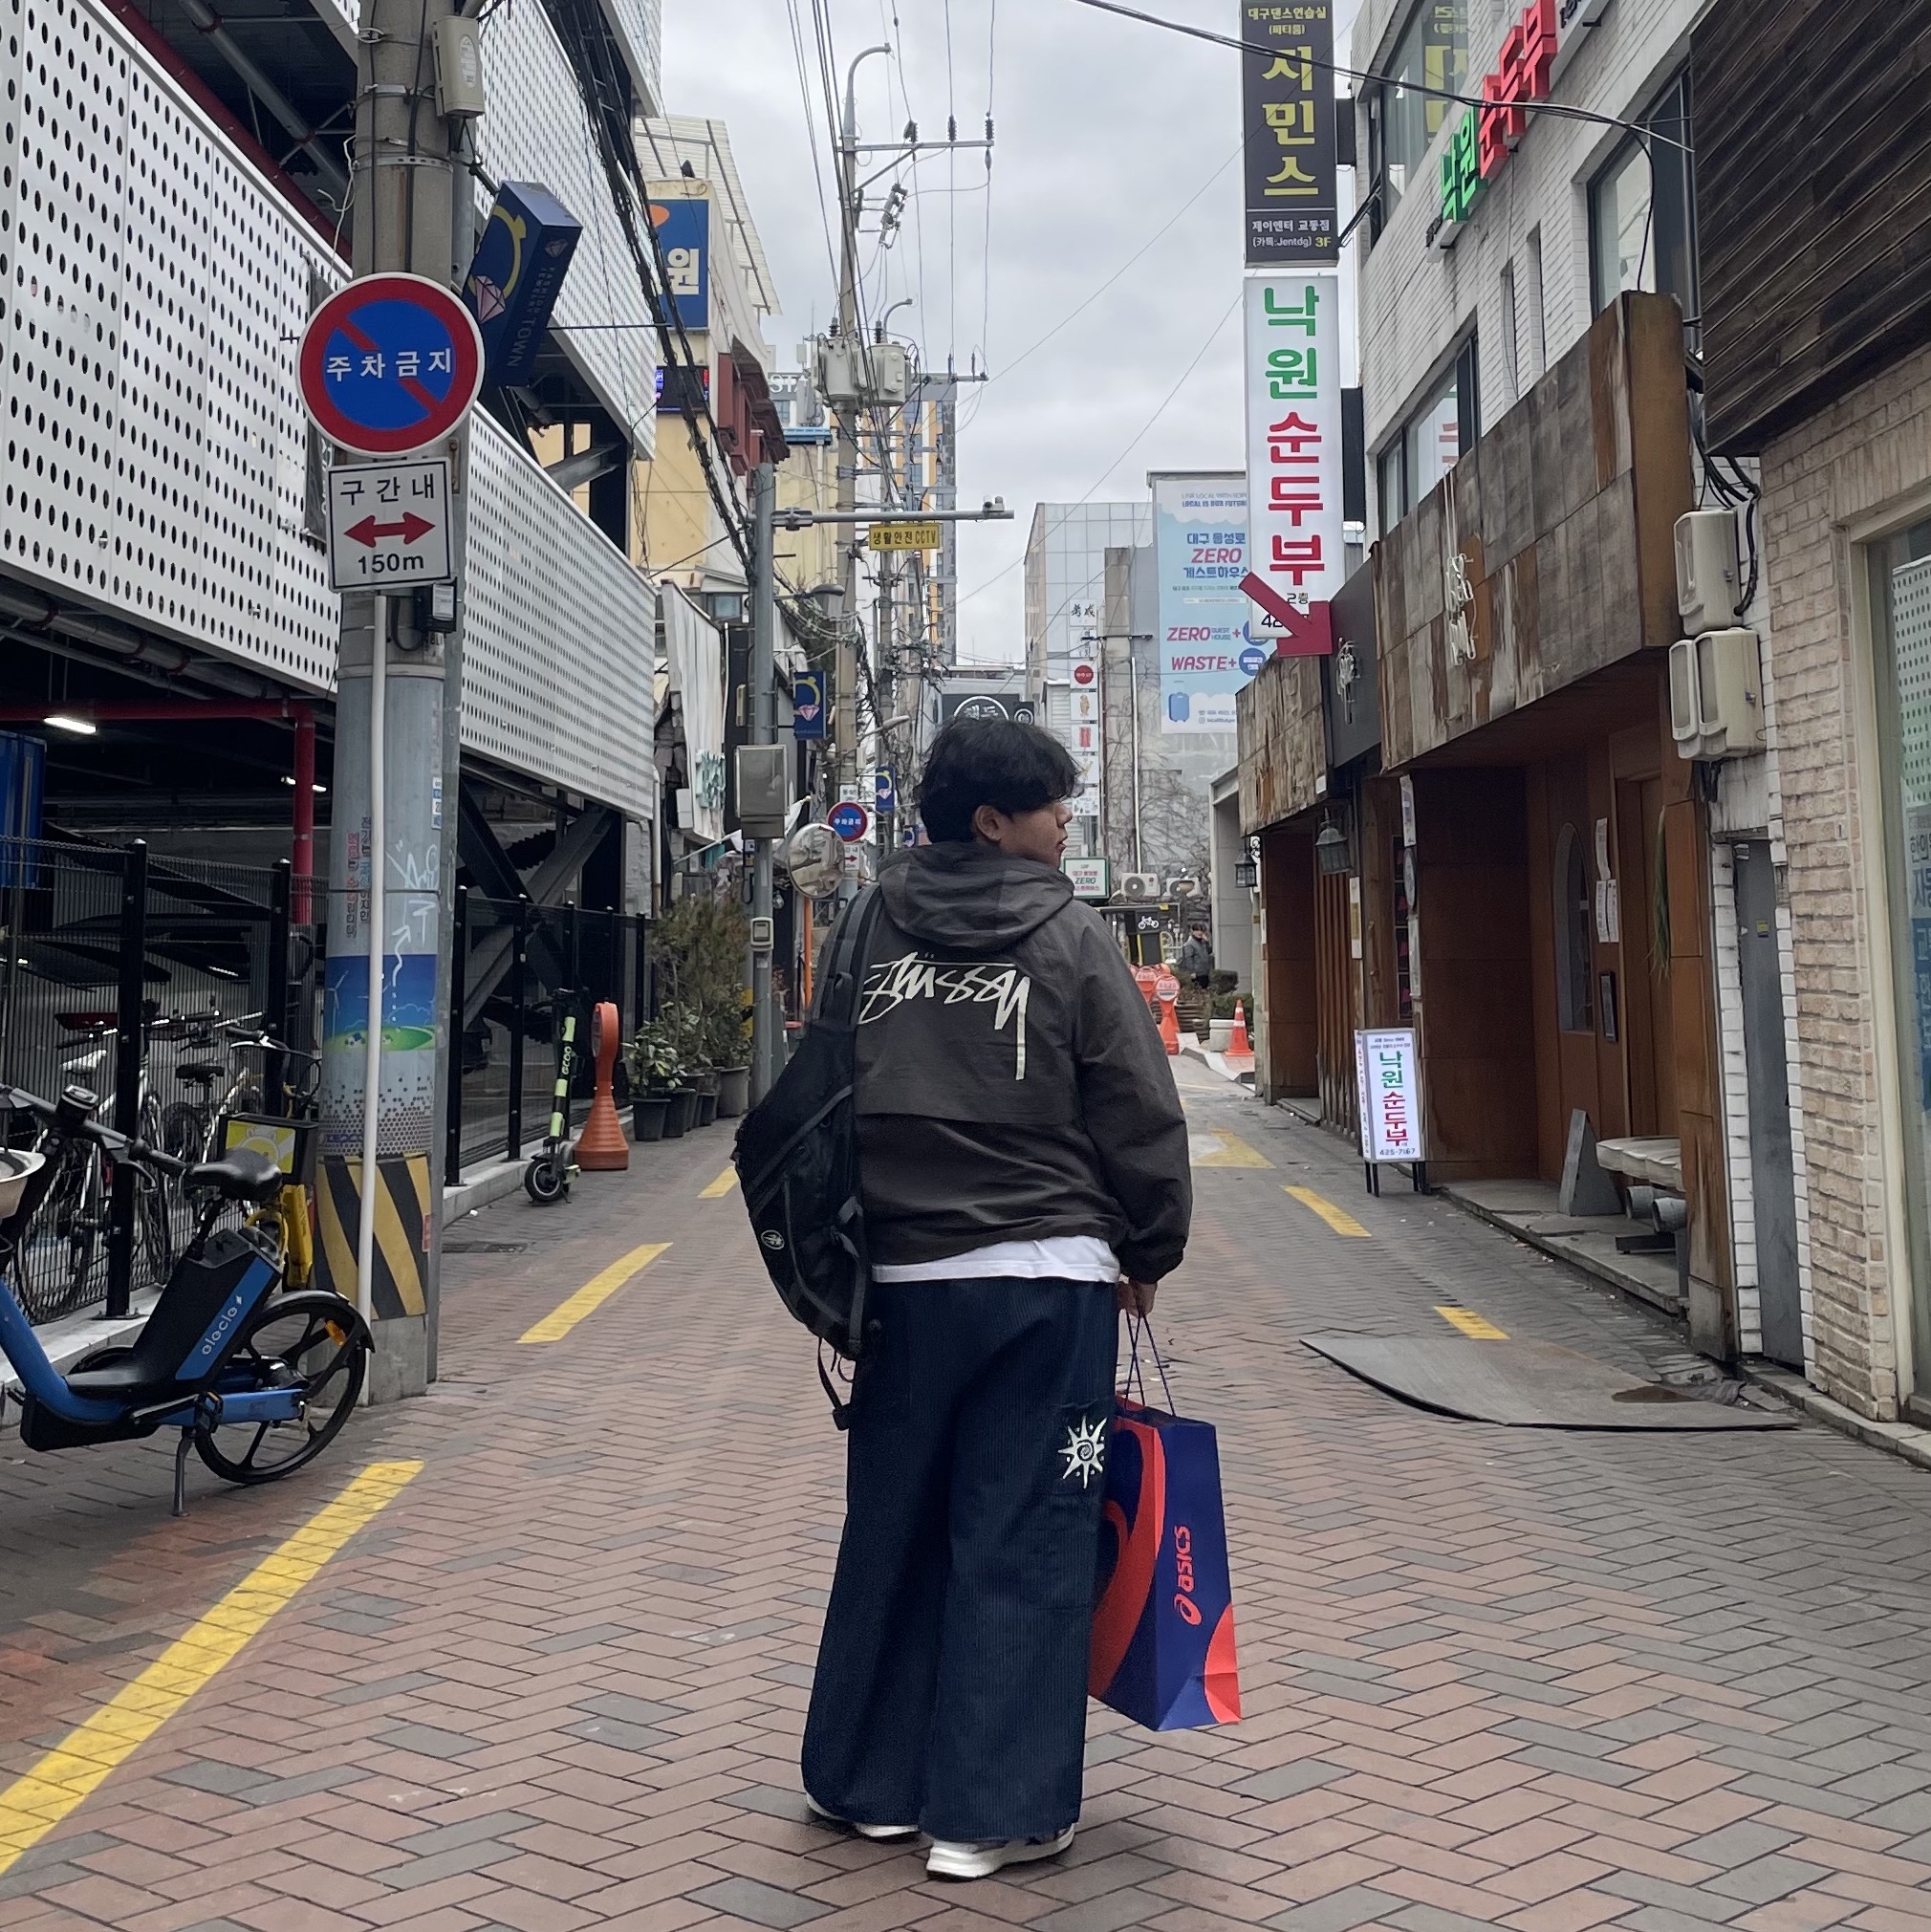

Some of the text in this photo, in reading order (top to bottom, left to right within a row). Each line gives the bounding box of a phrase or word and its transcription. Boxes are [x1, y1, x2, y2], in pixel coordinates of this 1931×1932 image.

[1314, 236, 1332, 248] 3F
[506, 318, 536, 367] TOWN
[1187, 532, 1209, 544] 대구
[1191, 548, 1242, 563] ZERO
[358, 553, 424, 575] 150m
[1166, 627, 1211, 641] ZERO
[1171, 656, 1227, 670] WASTE
